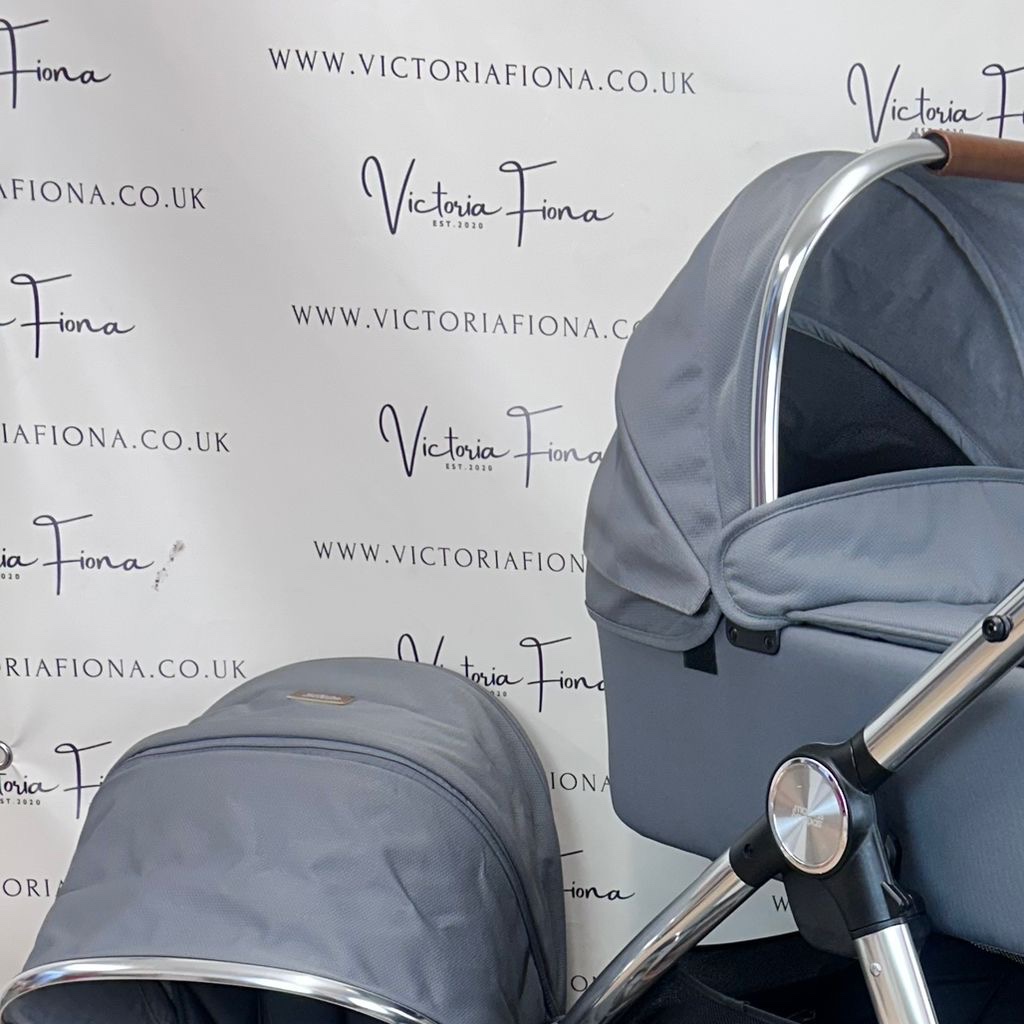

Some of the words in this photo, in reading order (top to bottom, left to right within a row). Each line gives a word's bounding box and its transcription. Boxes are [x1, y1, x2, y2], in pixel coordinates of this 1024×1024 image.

[267, 47, 696, 96] WWW.VICTORIAFIONA.CO.UK
[846, 62, 983, 144] Victoria
[361, 155, 502, 236] Victoria
[499, 160, 615, 248] Fiona
[432, 219, 485, 230] EST.2020
[10, 272, 136, 359] Fiona
[378, 403, 511, 478] Victoria
[445, 463, 494, 473] EST.2020
[32, 513, 155, 596] Fiona
[0, 656, 247, 680] RIAFIONA.CO.UK
